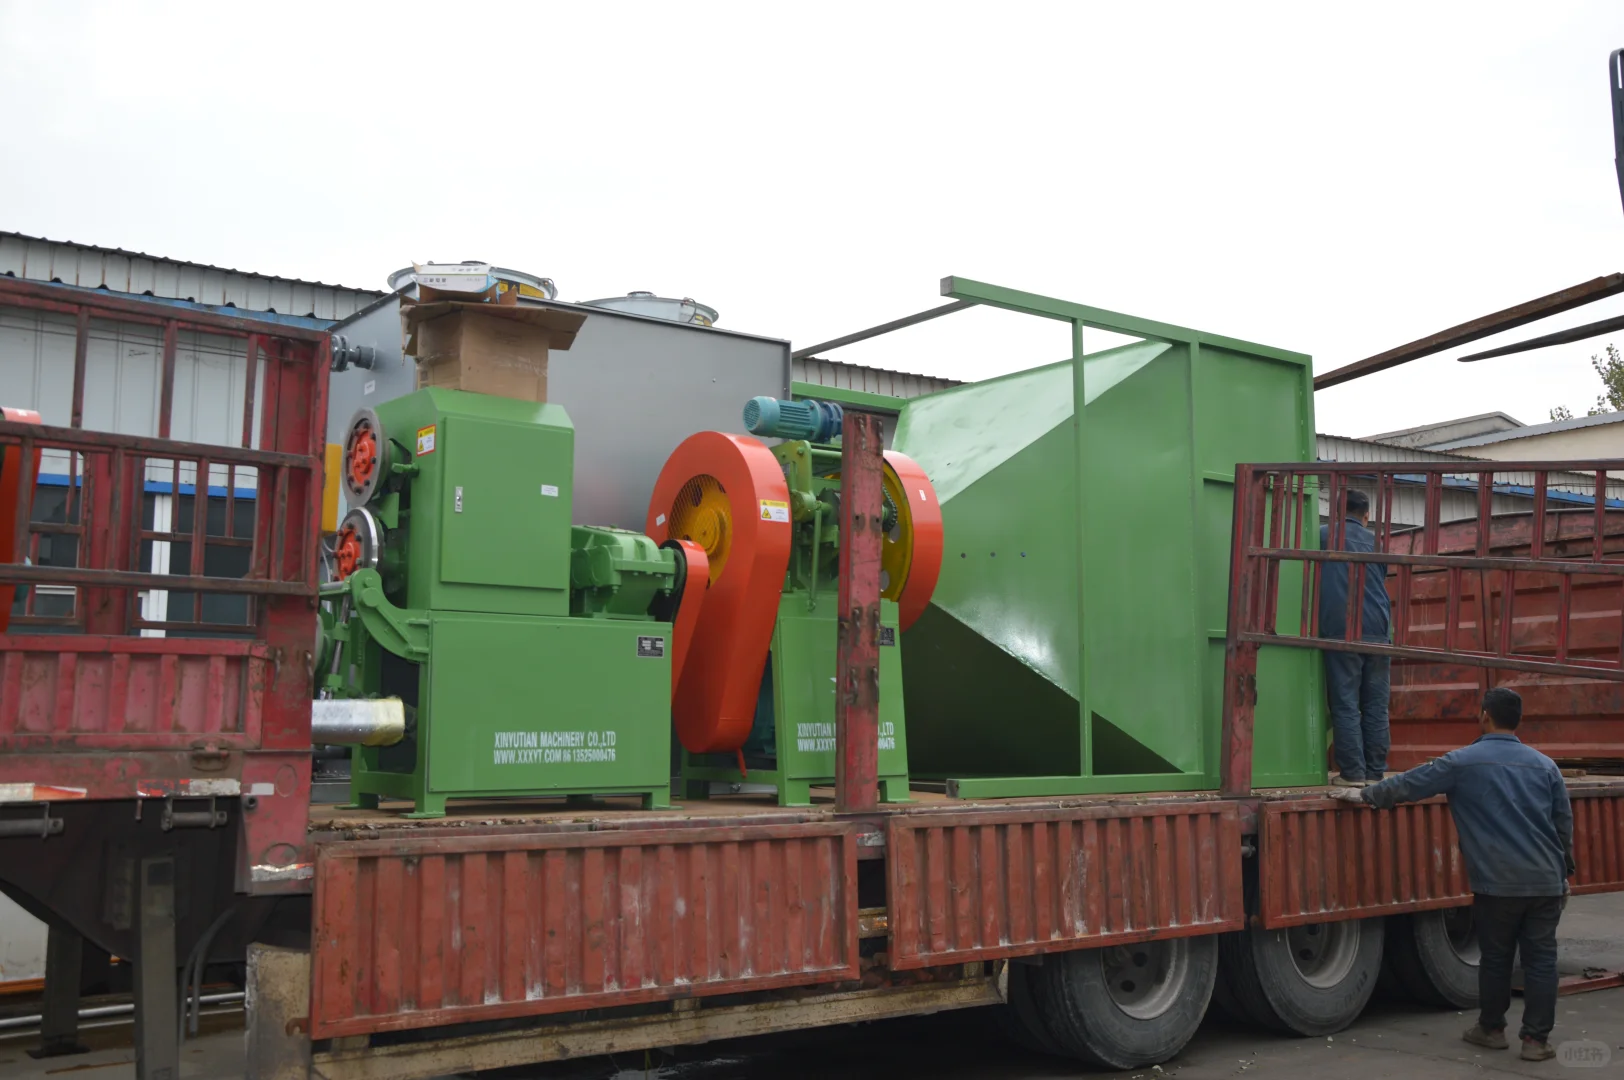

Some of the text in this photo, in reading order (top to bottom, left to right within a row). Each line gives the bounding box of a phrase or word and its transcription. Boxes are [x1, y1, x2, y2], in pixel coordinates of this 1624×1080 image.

[797, 722, 832, 738] XINYUTIAN
[878, 722, 894, 737] .,LTD
[494, 731, 538, 748] XINYUTIAN
[540, 731, 585, 748] MACHINERY
[797, 738, 836, 752] WWW.XXXYT
